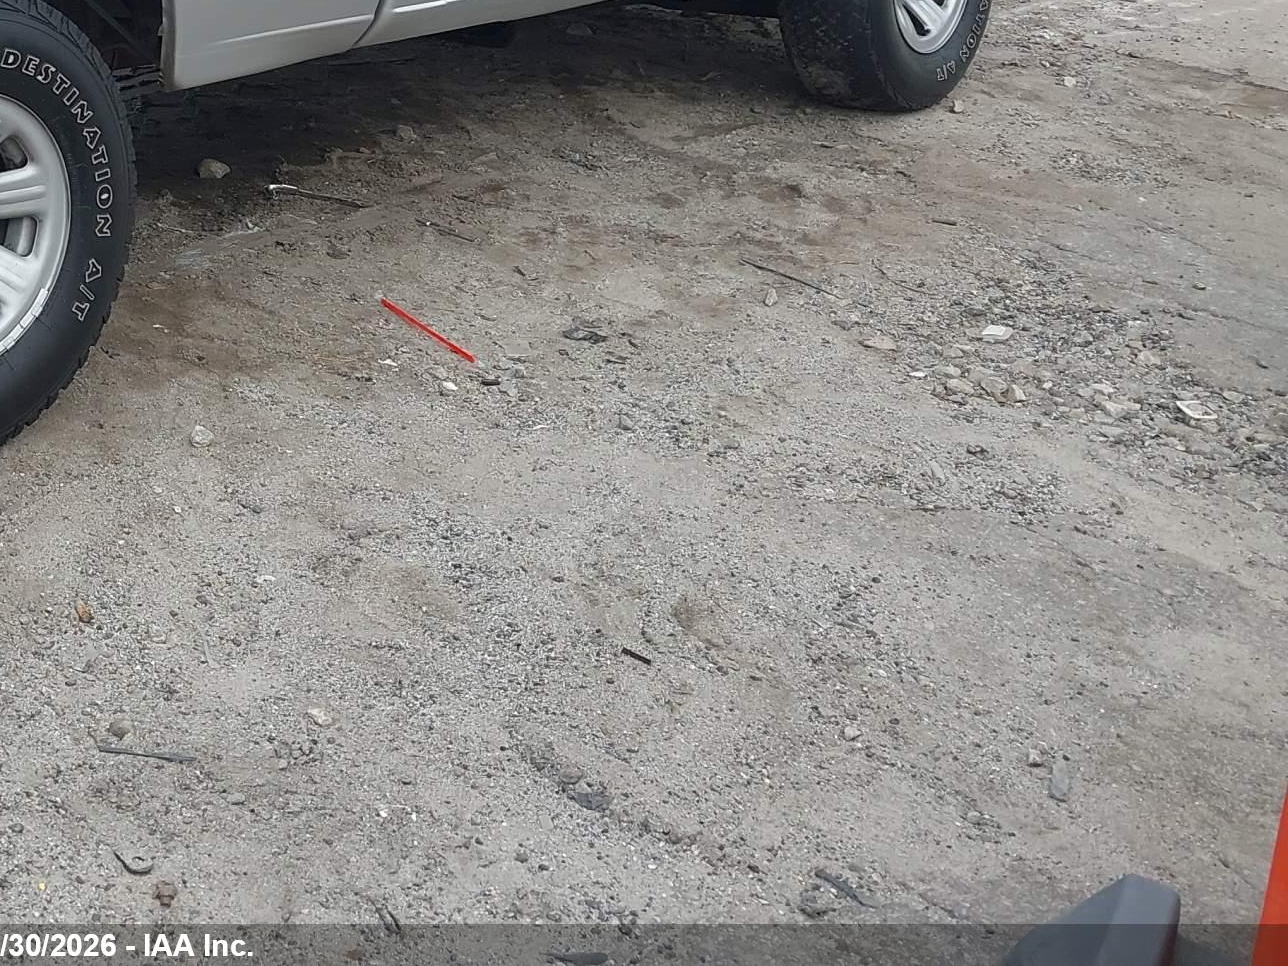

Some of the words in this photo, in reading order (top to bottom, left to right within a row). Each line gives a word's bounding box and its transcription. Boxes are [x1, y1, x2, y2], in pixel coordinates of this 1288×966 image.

[936, 59, 956, 81] A/T
[0, 48, 114, 238] DESTINATION
[72, 258, 102, 322] A/T
